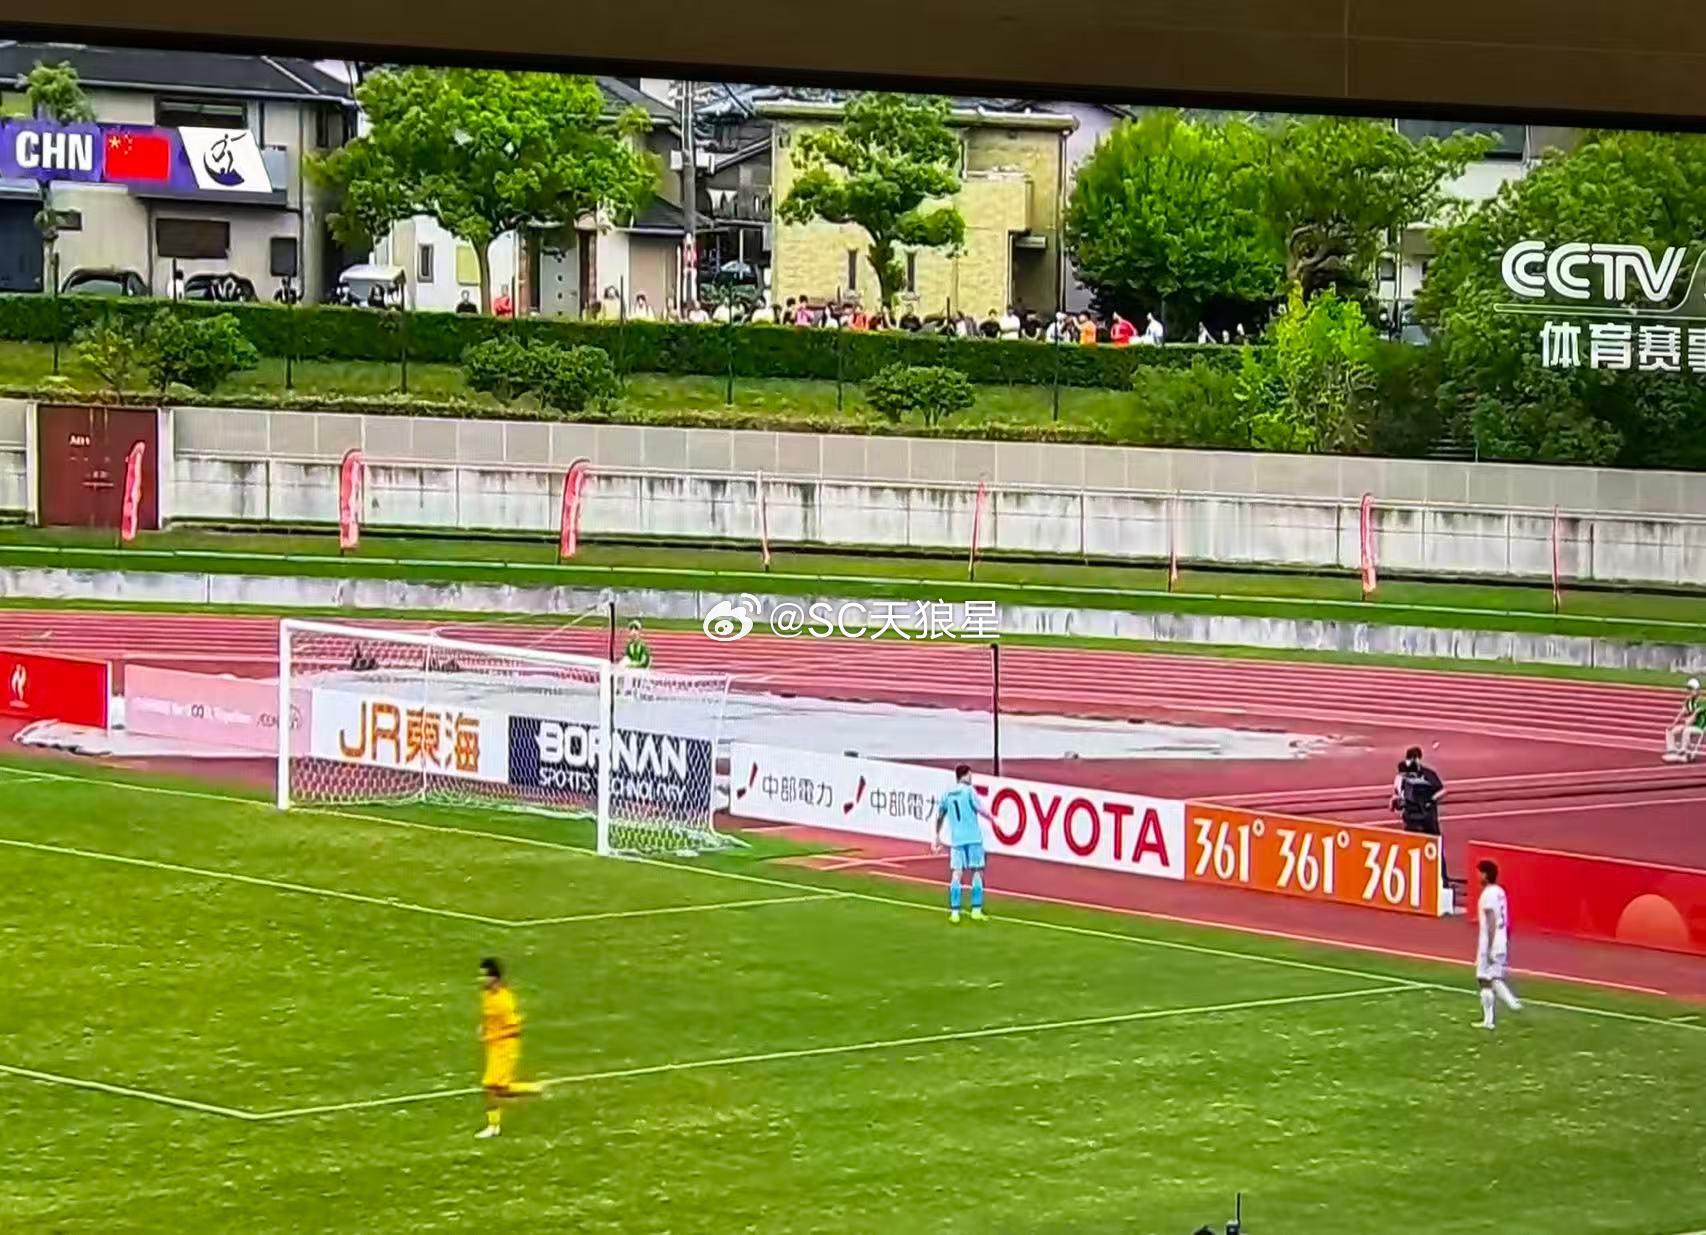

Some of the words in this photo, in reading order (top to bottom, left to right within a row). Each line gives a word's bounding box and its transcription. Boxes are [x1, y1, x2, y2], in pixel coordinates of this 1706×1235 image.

[16, 130, 93, 171] CHN
[1501, 240, 1687, 302] CCTV
[339, 701, 481, 773] JR東海
[594, 774, 688, 802] CHNOLOGY
[762, 774, 833, 808] 中部電力
[953, 799, 961, 822] 1
